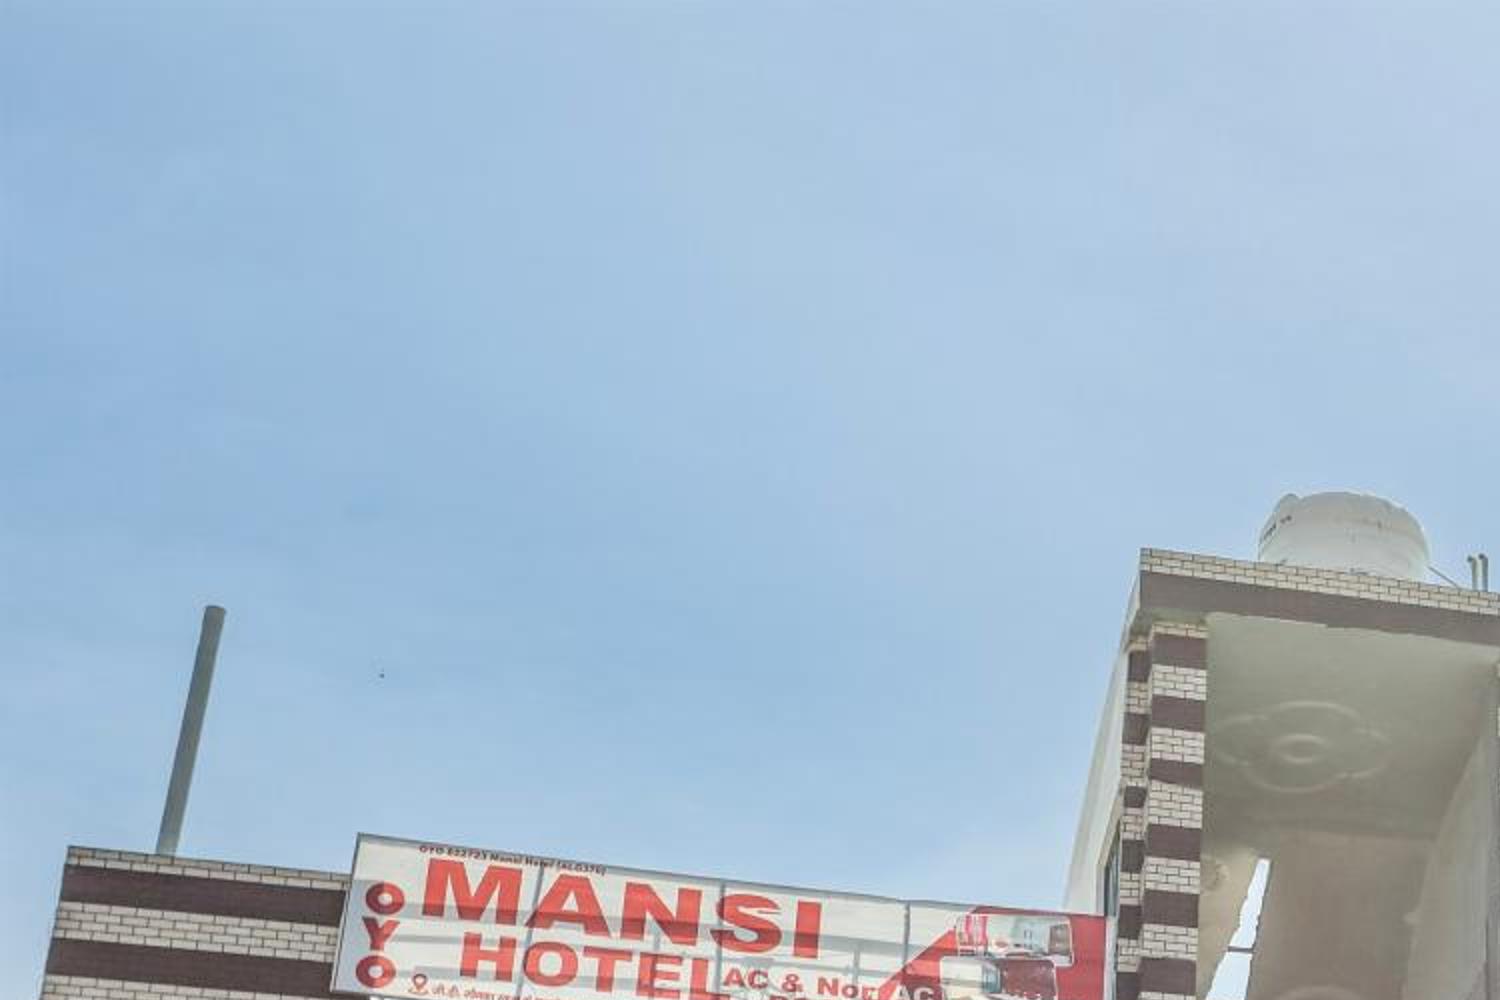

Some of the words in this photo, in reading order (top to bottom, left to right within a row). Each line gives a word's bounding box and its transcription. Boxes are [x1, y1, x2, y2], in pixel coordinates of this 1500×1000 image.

[421, 858, 822, 960] MANSI
[723, 968, 769, 990] AC
[781, 973, 803, 993] &
